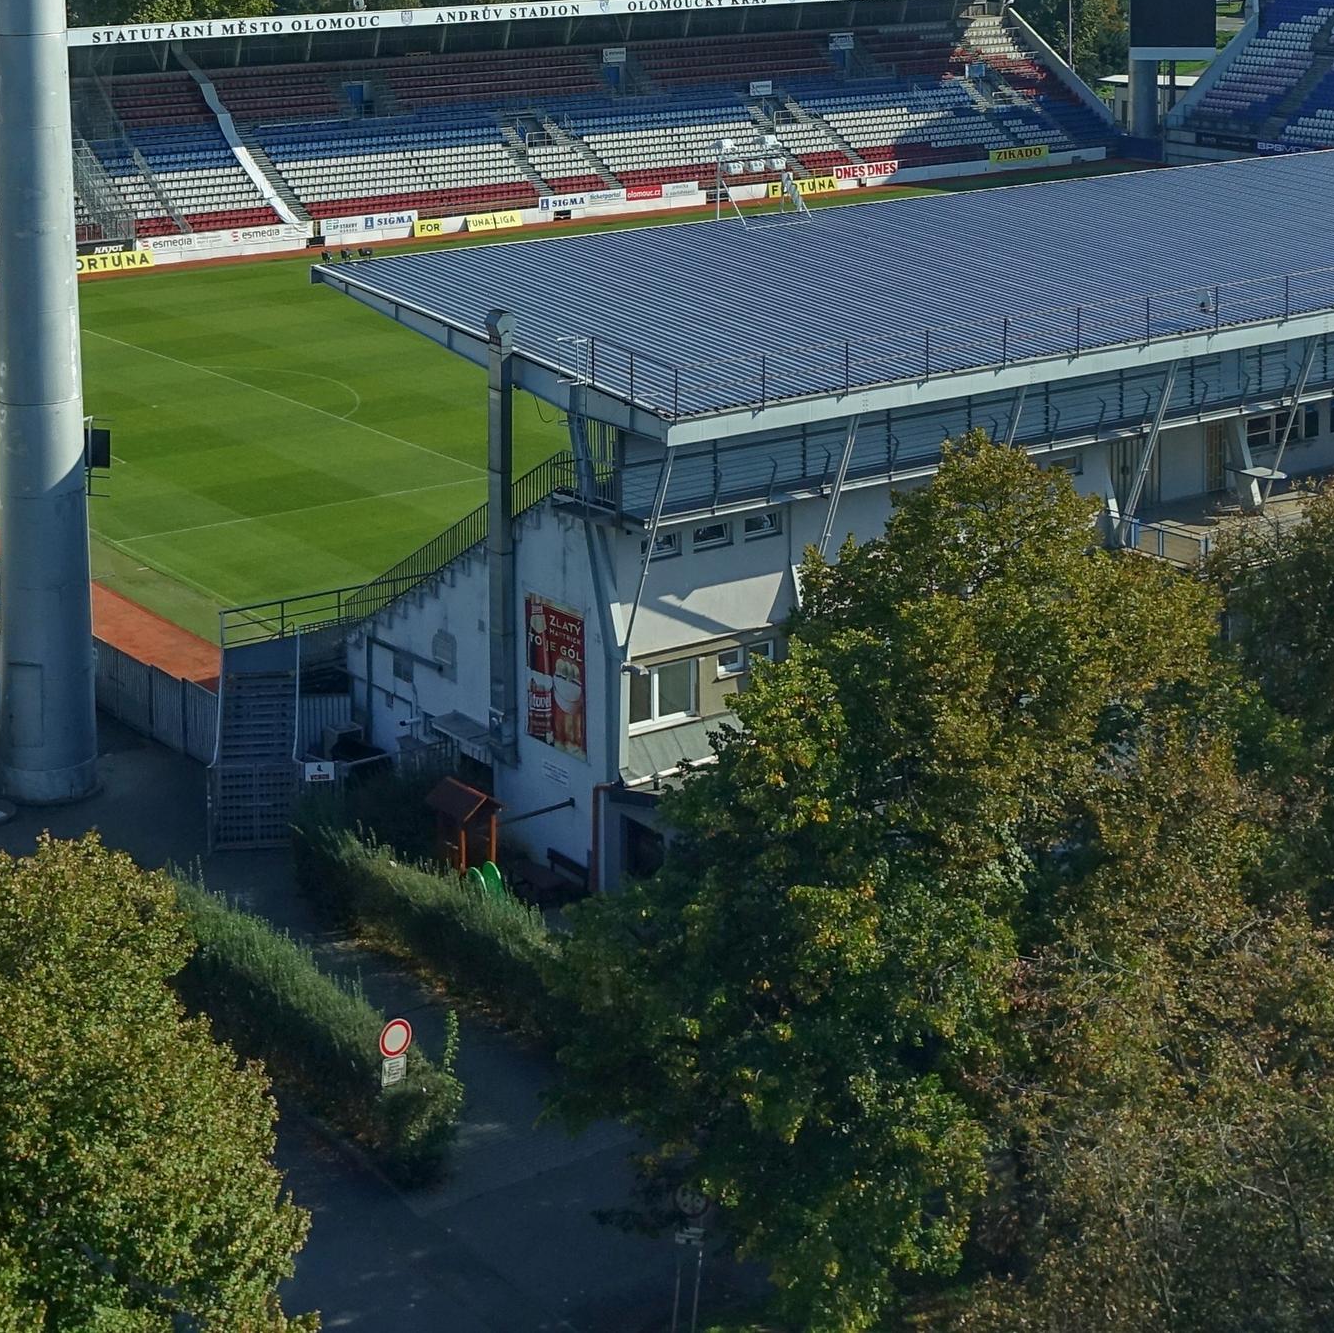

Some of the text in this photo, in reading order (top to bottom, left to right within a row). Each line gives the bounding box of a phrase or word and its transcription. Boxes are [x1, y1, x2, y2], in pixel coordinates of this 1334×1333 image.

[435, 4, 581, 23] ANDRŮV STADION
[92, 15, 380, 43] STATUTÁRNÍ MĚSTO OLOMOUC
[996, 147, 1042, 160] ZIKADO
[836, 162, 896, 179] DNES DNES
[628, 189, 661, 198] olomouc.cz
[772, 178, 835, 195] FTUNA
[552, 197, 584, 207] SIGMA
[377, 215, 413, 226] SIGMA
[420, 223, 440, 233] FOR
[242, 229, 280, 240] esmedia
[153, 237, 193, 248] esmedia
[76, 253, 149, 271] ORTUNA
[549, 615, 581, 635] ZLATÝ
[529, 632, 542, 645] TO
[560, 644, 583, 662] GÓL
